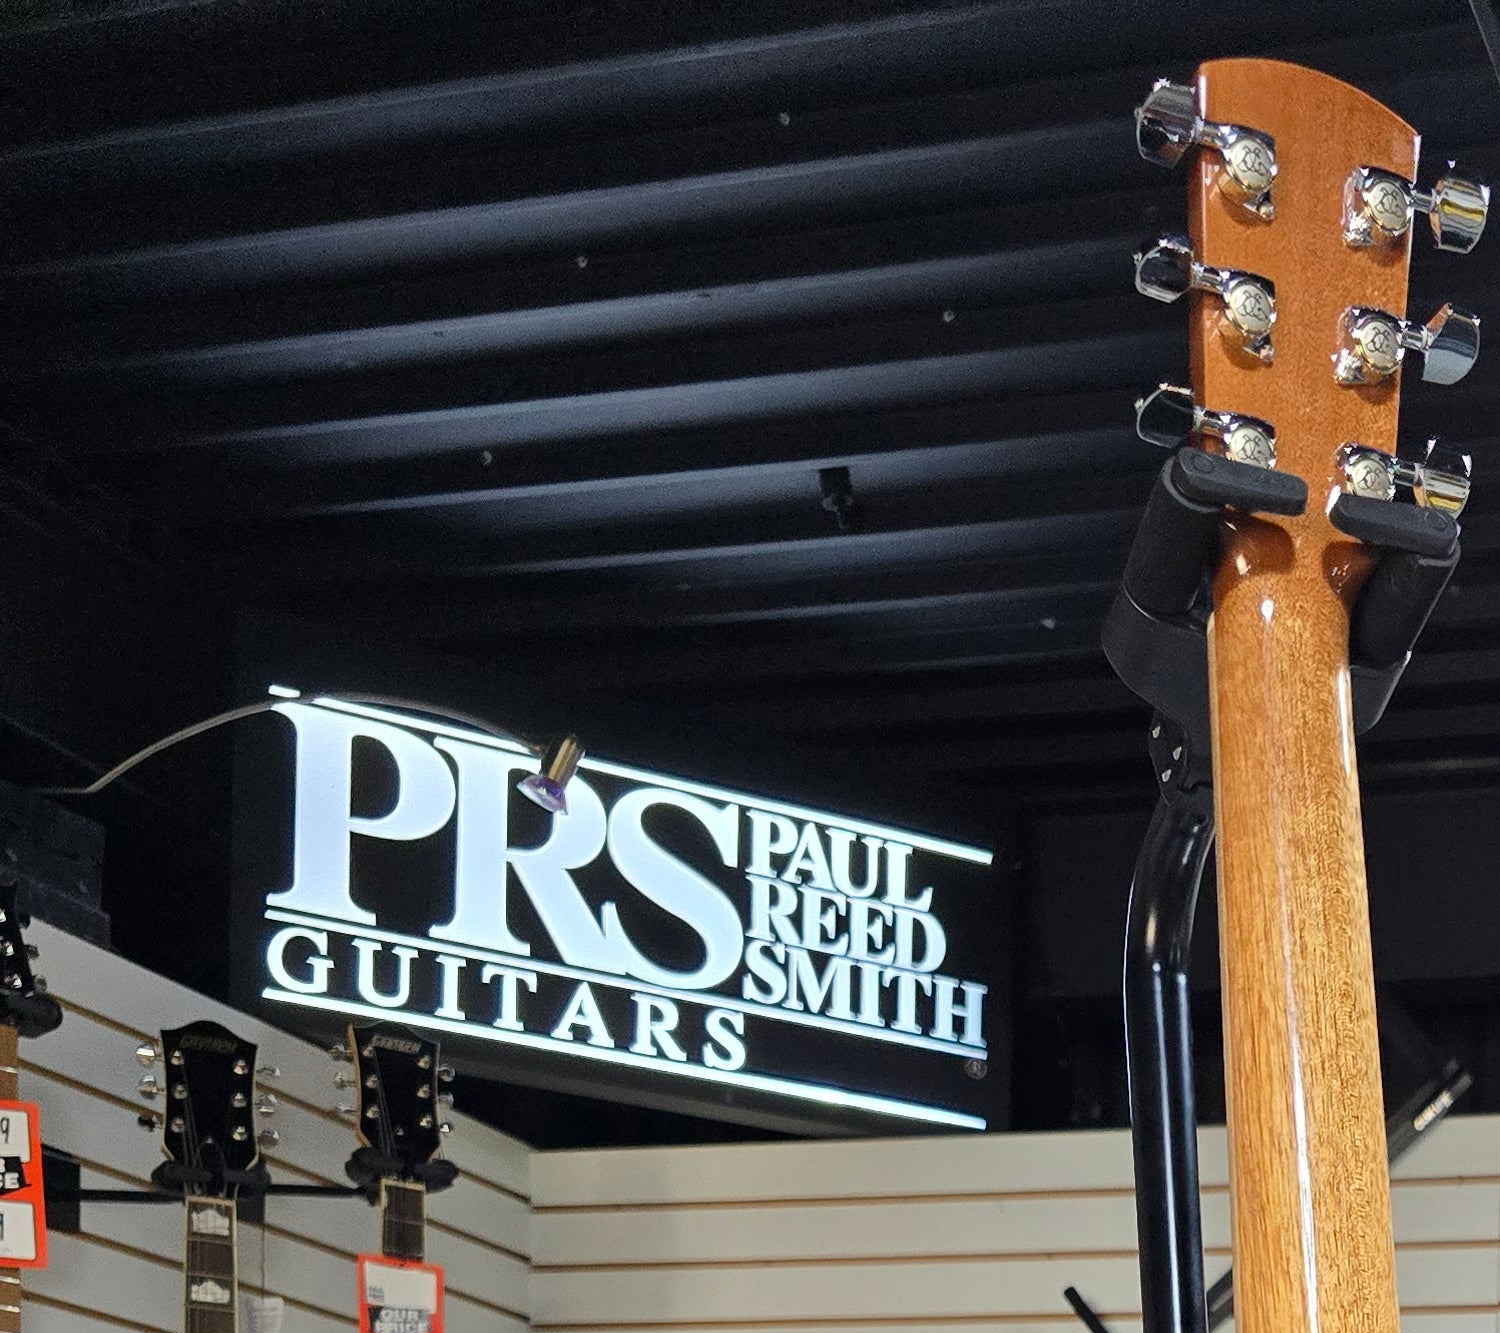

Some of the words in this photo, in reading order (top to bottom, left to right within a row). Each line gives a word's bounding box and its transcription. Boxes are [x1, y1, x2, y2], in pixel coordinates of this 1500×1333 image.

[266, 702, 744, 990] PRS
[746, 808, 933, 912] PAUL
[745, 873, 946, 973] REED
[266, 926, 747, 1081] GUITARS
[743, 939, 988, 1048] SMITH
[380, 1308, 420, 1323] OUR
